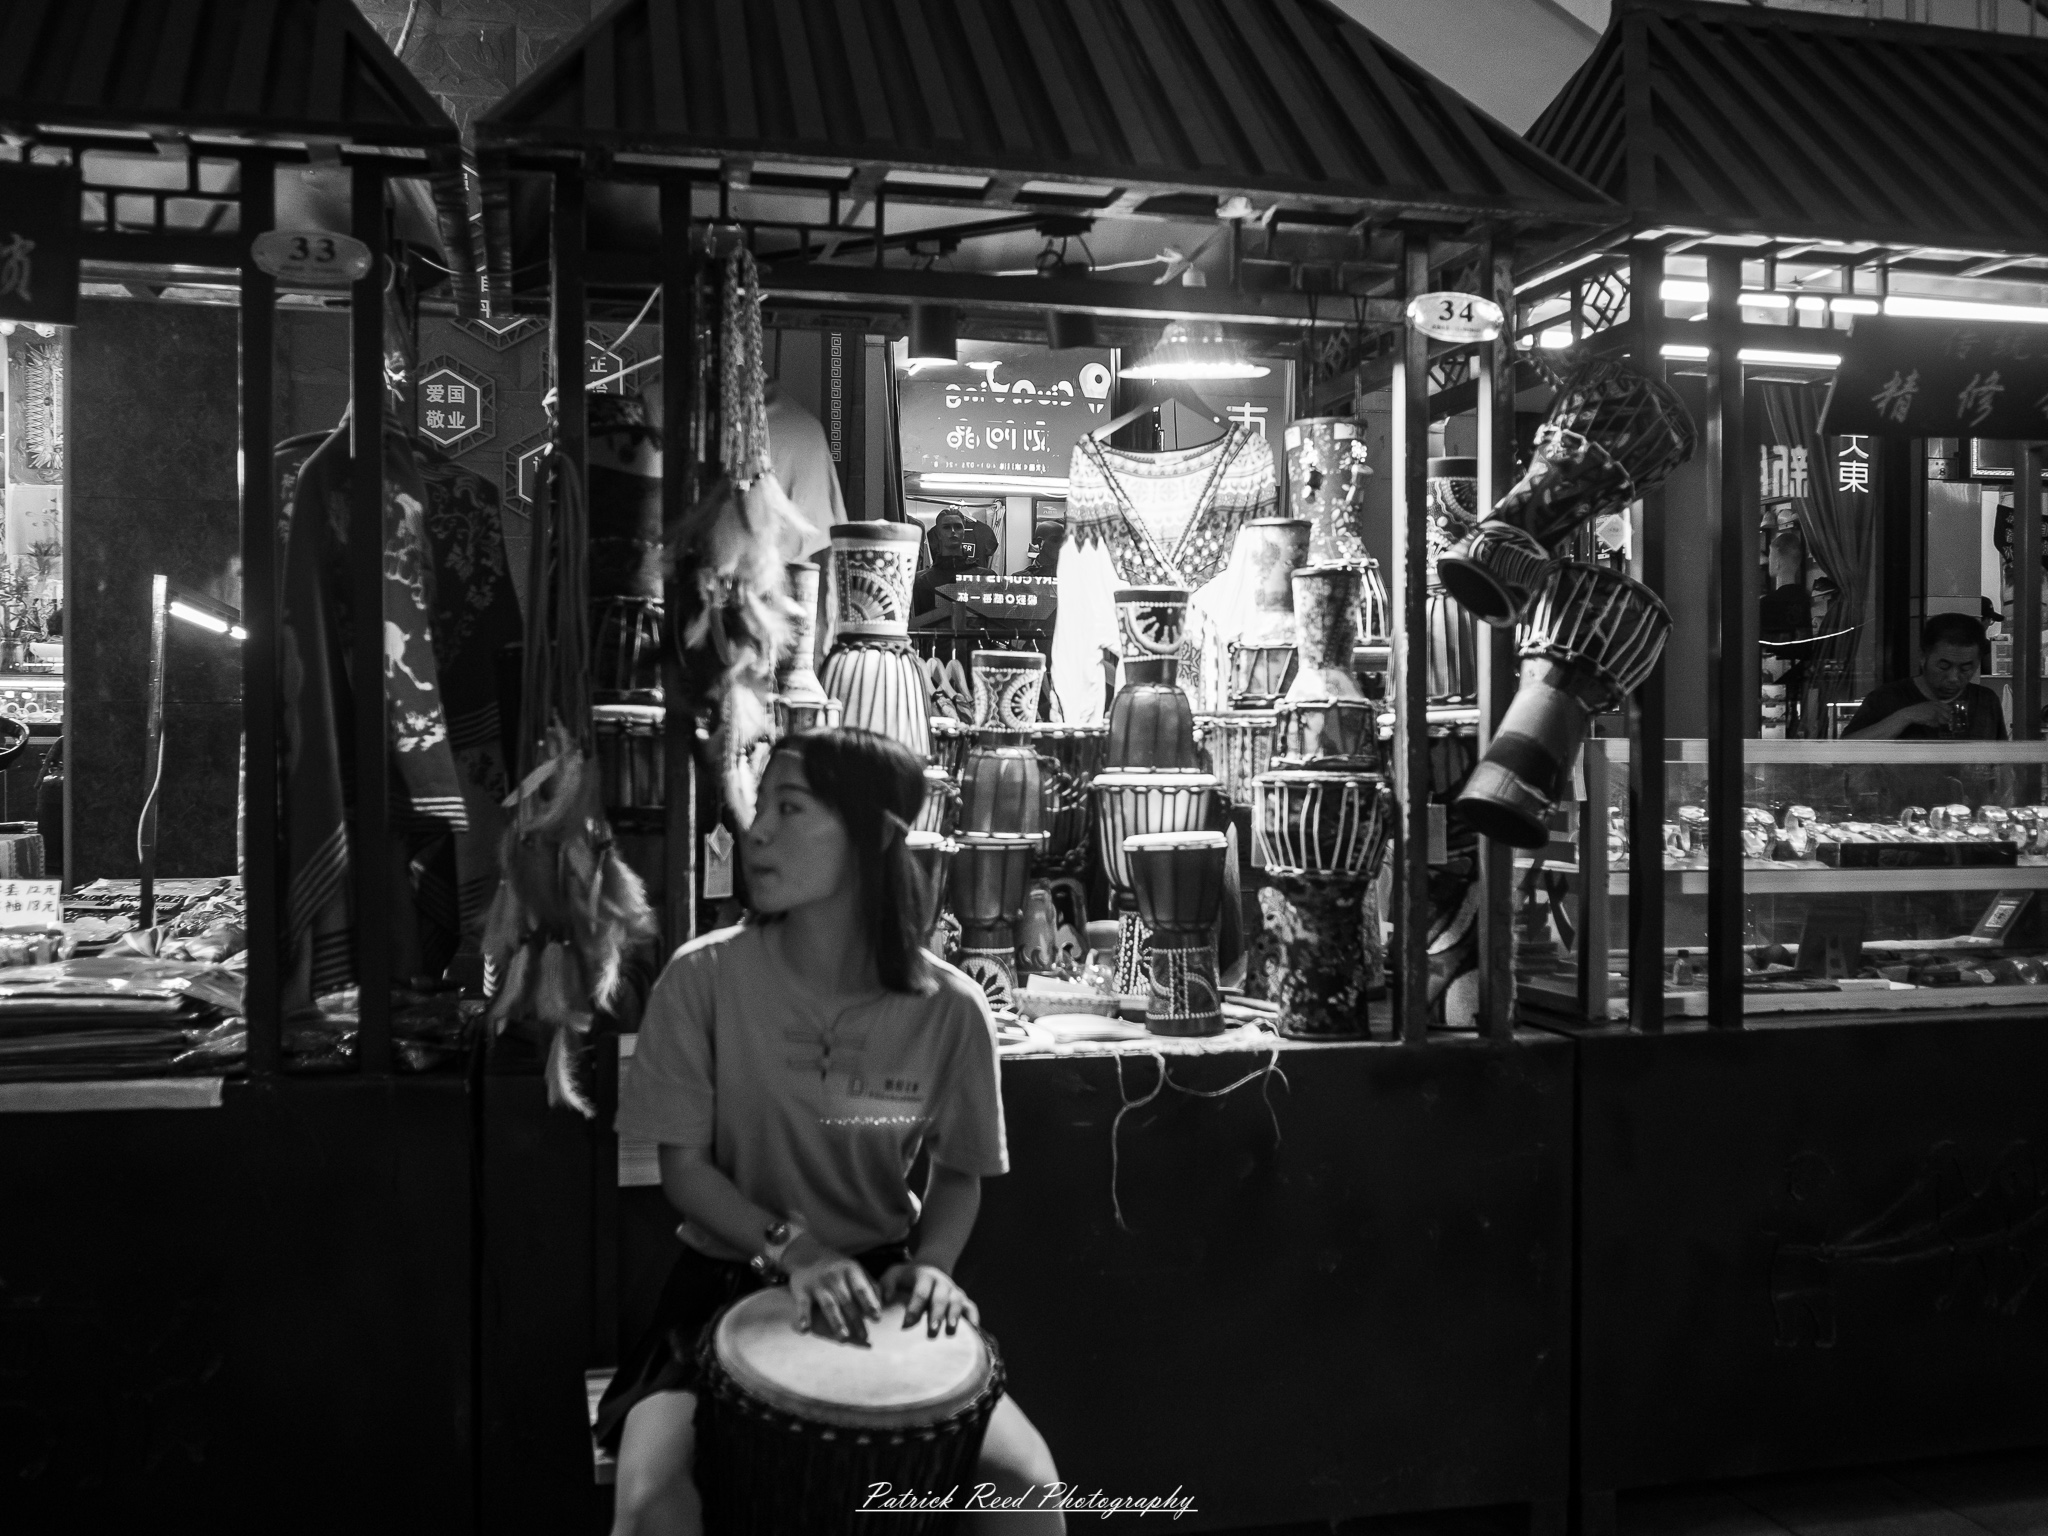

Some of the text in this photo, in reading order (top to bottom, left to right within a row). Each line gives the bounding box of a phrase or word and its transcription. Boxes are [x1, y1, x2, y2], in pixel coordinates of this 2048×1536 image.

[289, 237, 336, 263] 33
[1439, 300, 1474, 322] 34
[426, 384, 465, 404] 爱国
[426, 410, 466, 429] 敬业
